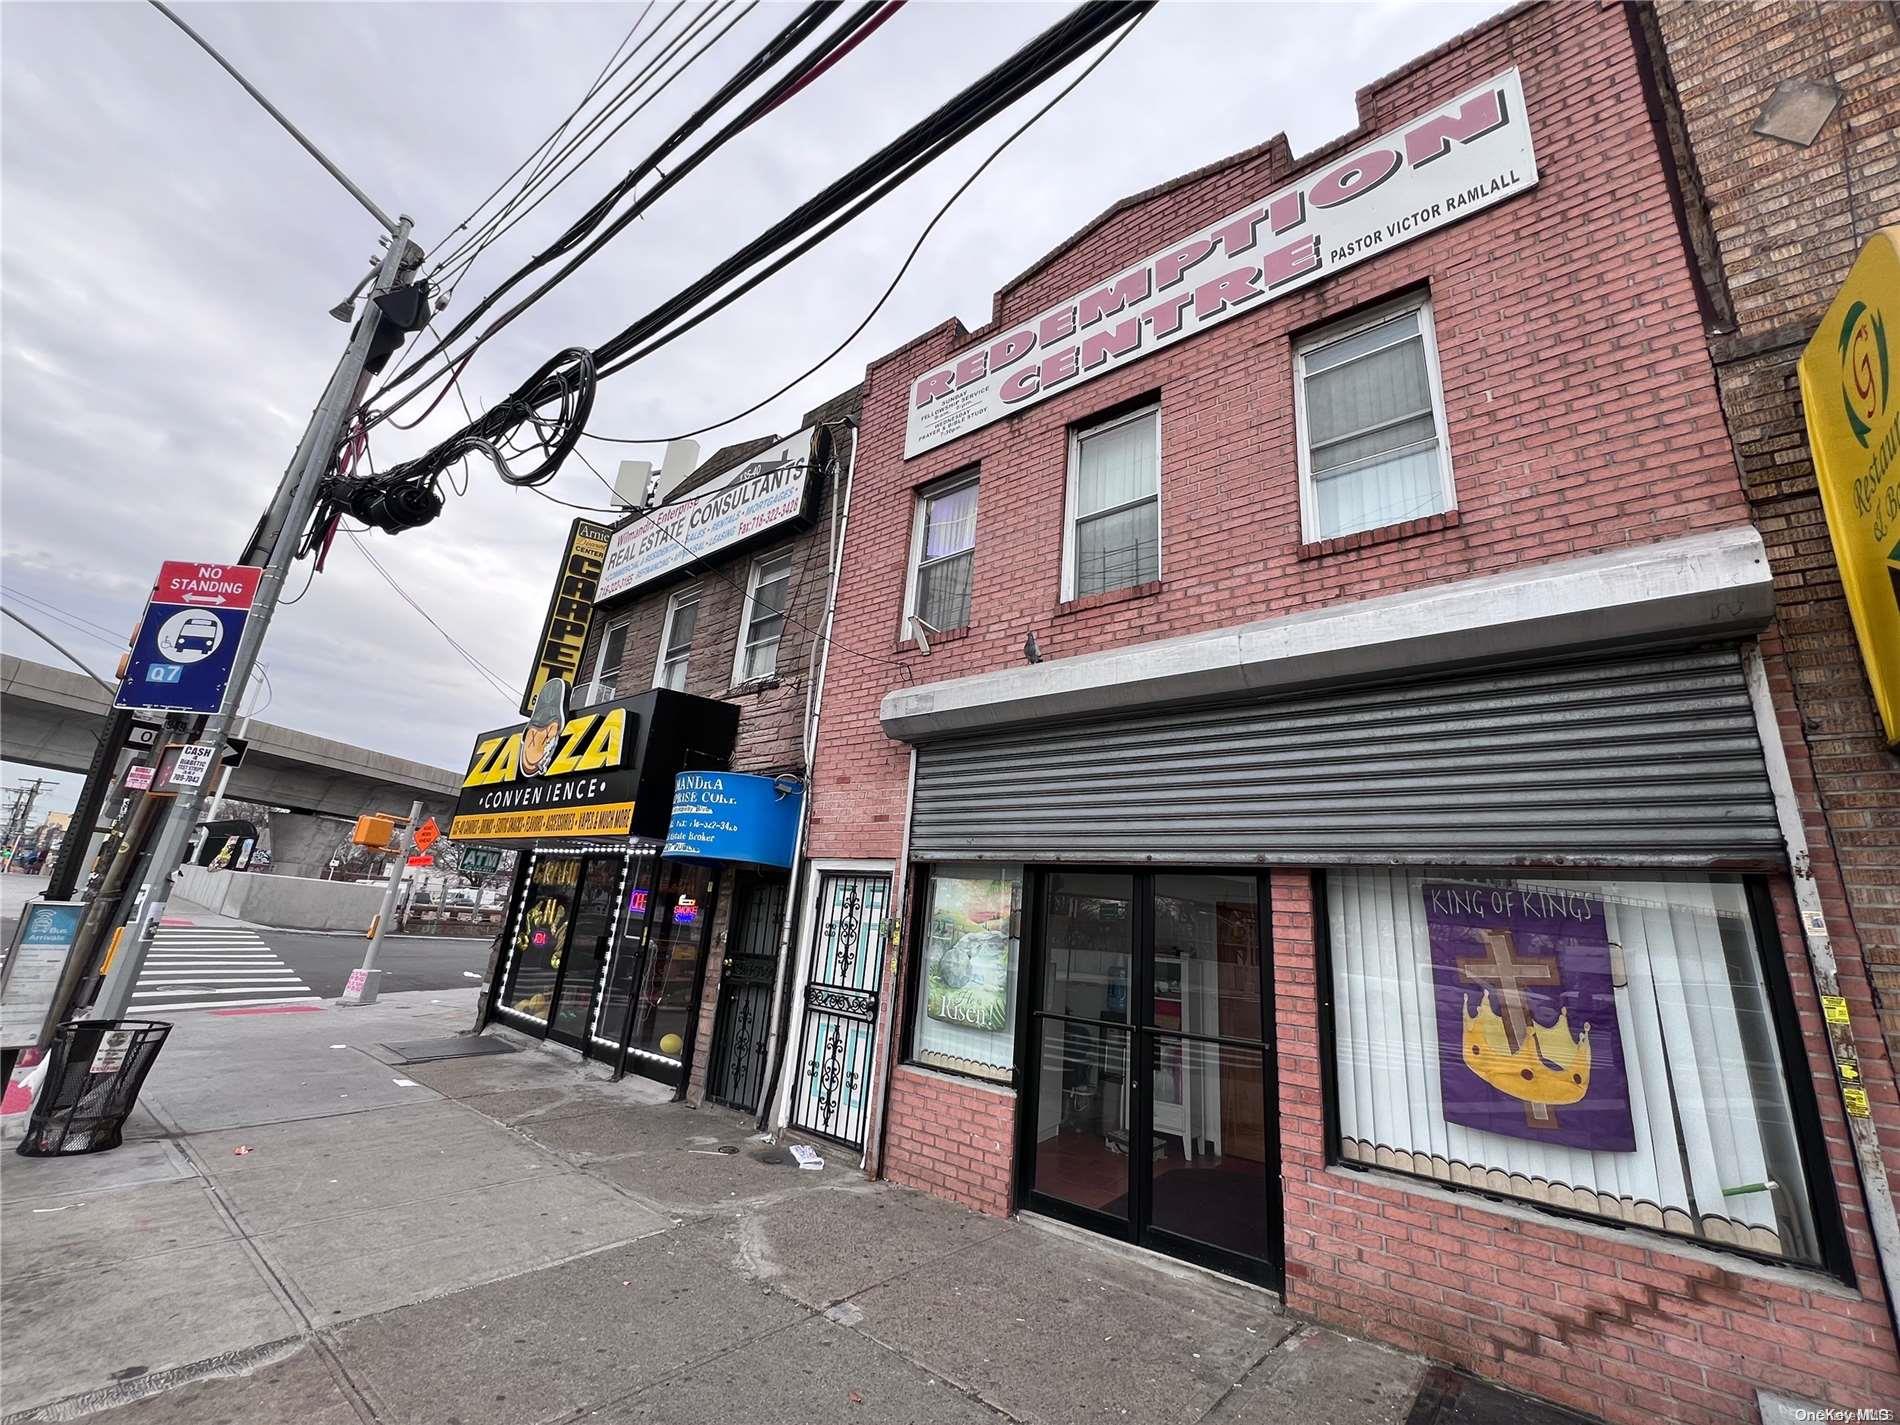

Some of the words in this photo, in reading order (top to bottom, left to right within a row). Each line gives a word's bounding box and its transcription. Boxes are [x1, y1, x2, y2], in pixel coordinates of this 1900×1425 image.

[1331, 230, 1383, 264] PASTOR
[1386, 203, 1442, 238] VICTOR
[1446, 169, 1521, 212] RAMLALL
[915, 88, 1511, 410] REDEMPTION
[999, 234, 1323, 405] CENTRE
[921, 401, 960, 421] FELLOWSHIP
[962, 386, 990, 403] SERVICE
[941, 390, 968, 406] SUNDAY
[918, 427, 943, 442] PRAYER
[947, 415, 965, 428] BIBLE
[967, 407, 988, 419] STUDY
[934, 409, 971, 429] WEDNESDAY
[607, 543, 636, 570] REAL
[638, 517, 686, 555] ESTATE
[690, 456, 805, 529] CONSULTANTS
[575, 545, 605, 559] CENTER
[170, 578, 243, 594] STANDING
[198, 567, 222, 579] NO
[541, 553, 602, 683] CARPET
[150, 665, 181, 681] Q7
[184, 745, 212, 757] CASH
[462, 850, 500, 868] ATM
[1431, 888, 1485, 919] KING
[1490, 890, 1515, 918] OF
[1521, 890, 1592, 922] KINGS
[938, 995, 994, 1026] Risen!
